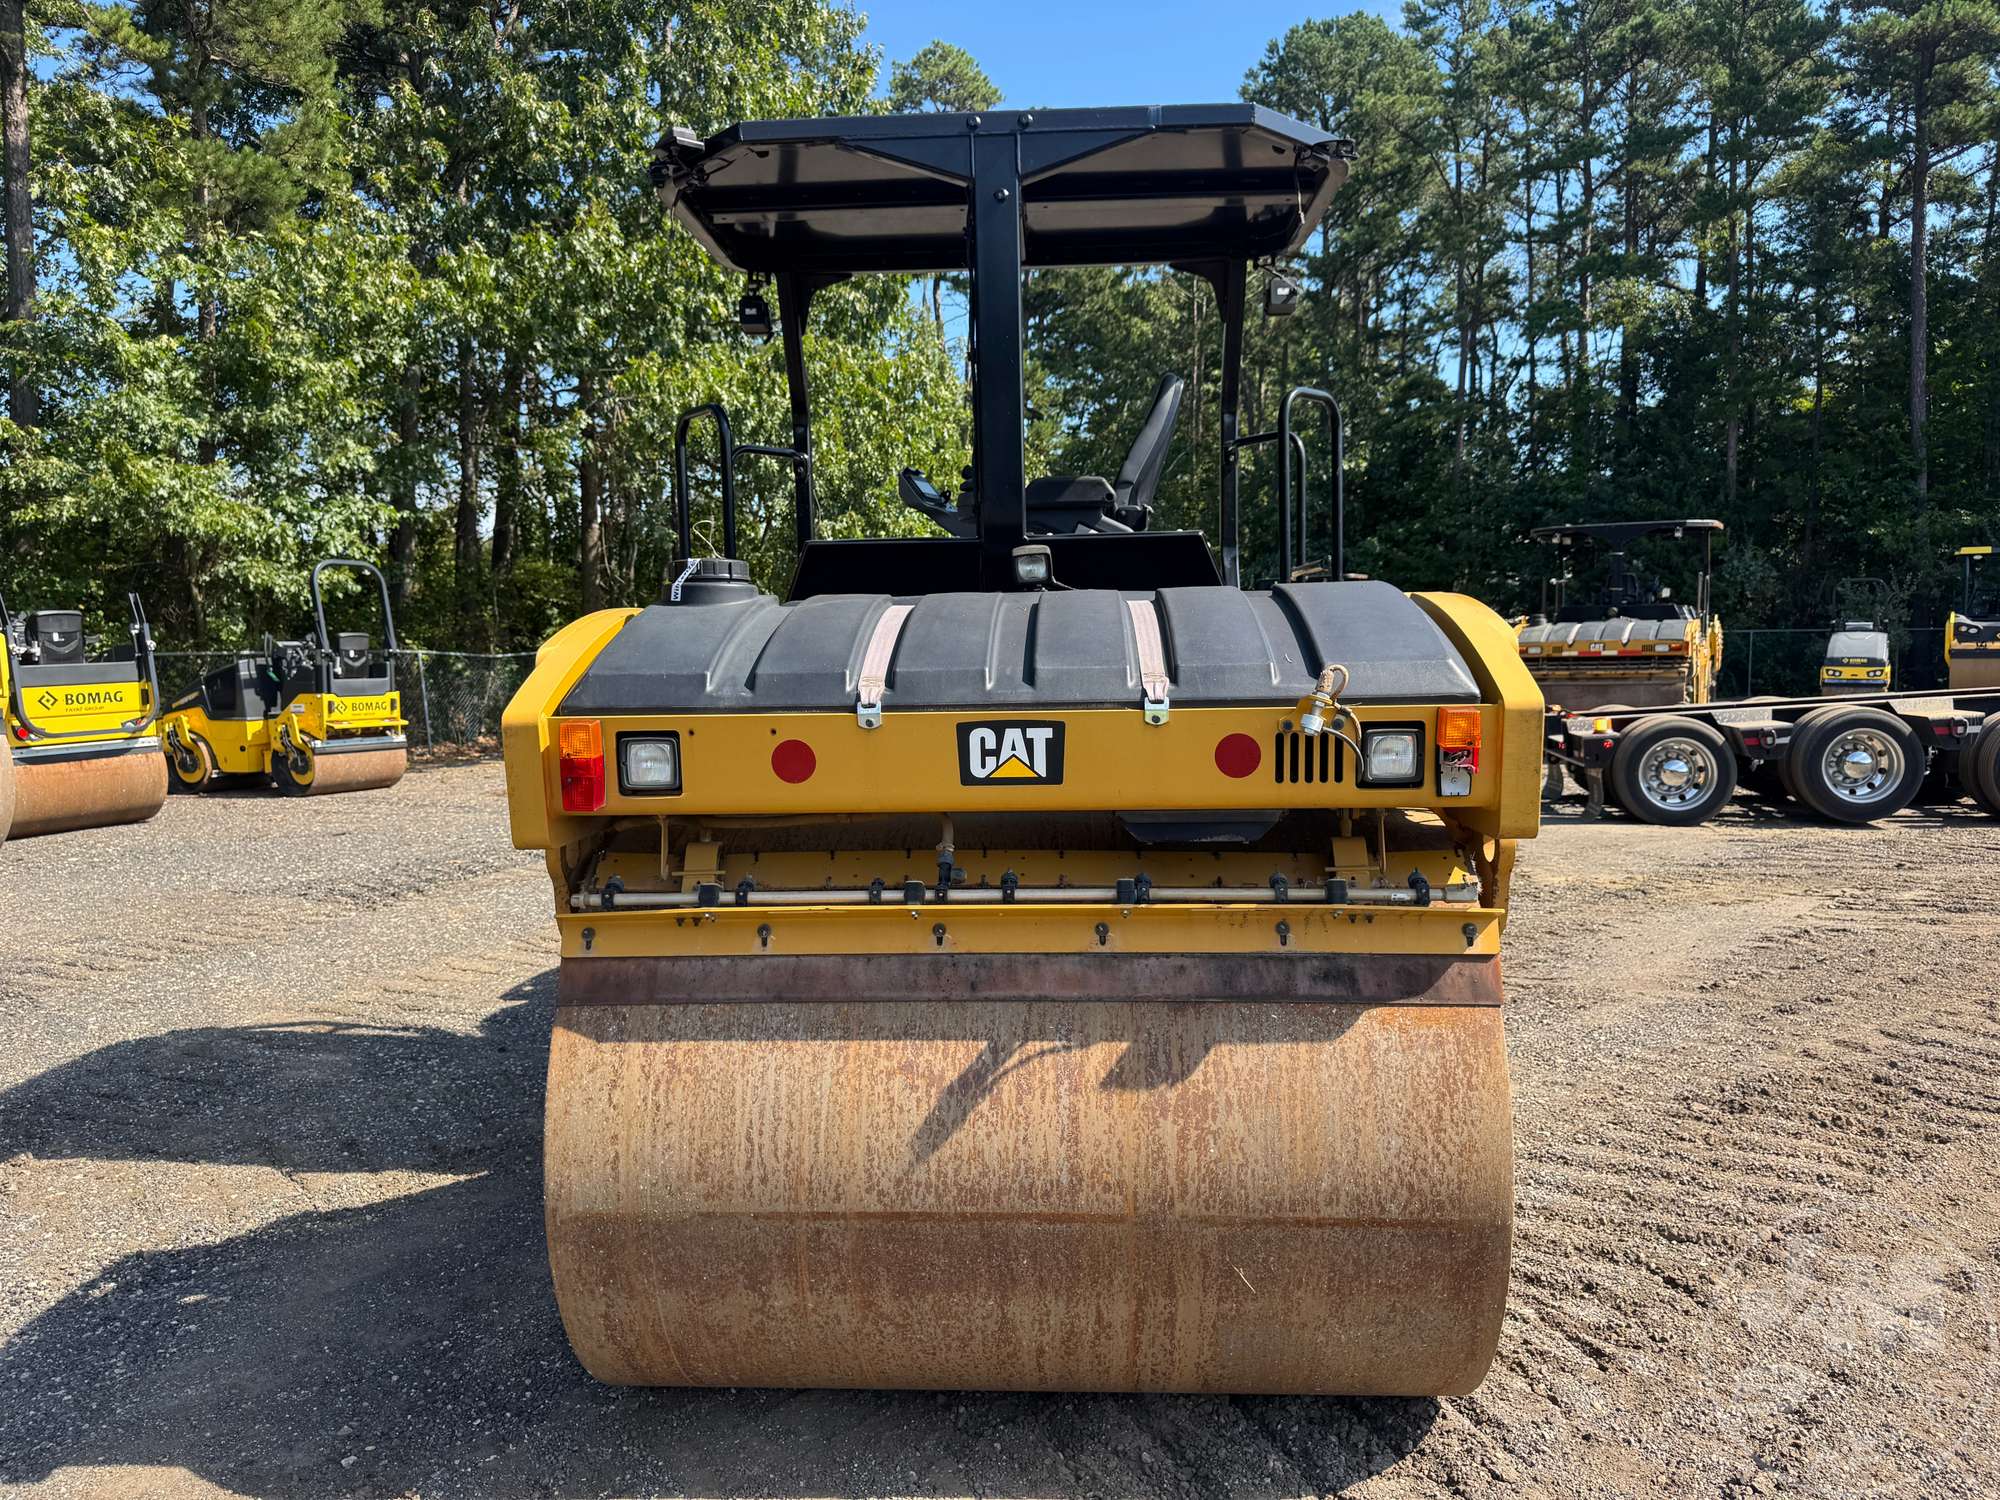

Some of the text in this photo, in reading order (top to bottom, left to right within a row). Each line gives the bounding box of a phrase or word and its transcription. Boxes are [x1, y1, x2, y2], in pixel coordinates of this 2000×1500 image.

[65, 691, 123, 706] BOMAG
[351, 701, 387, 712] BOMAG
[969, 727, 1053, 778] CAT
